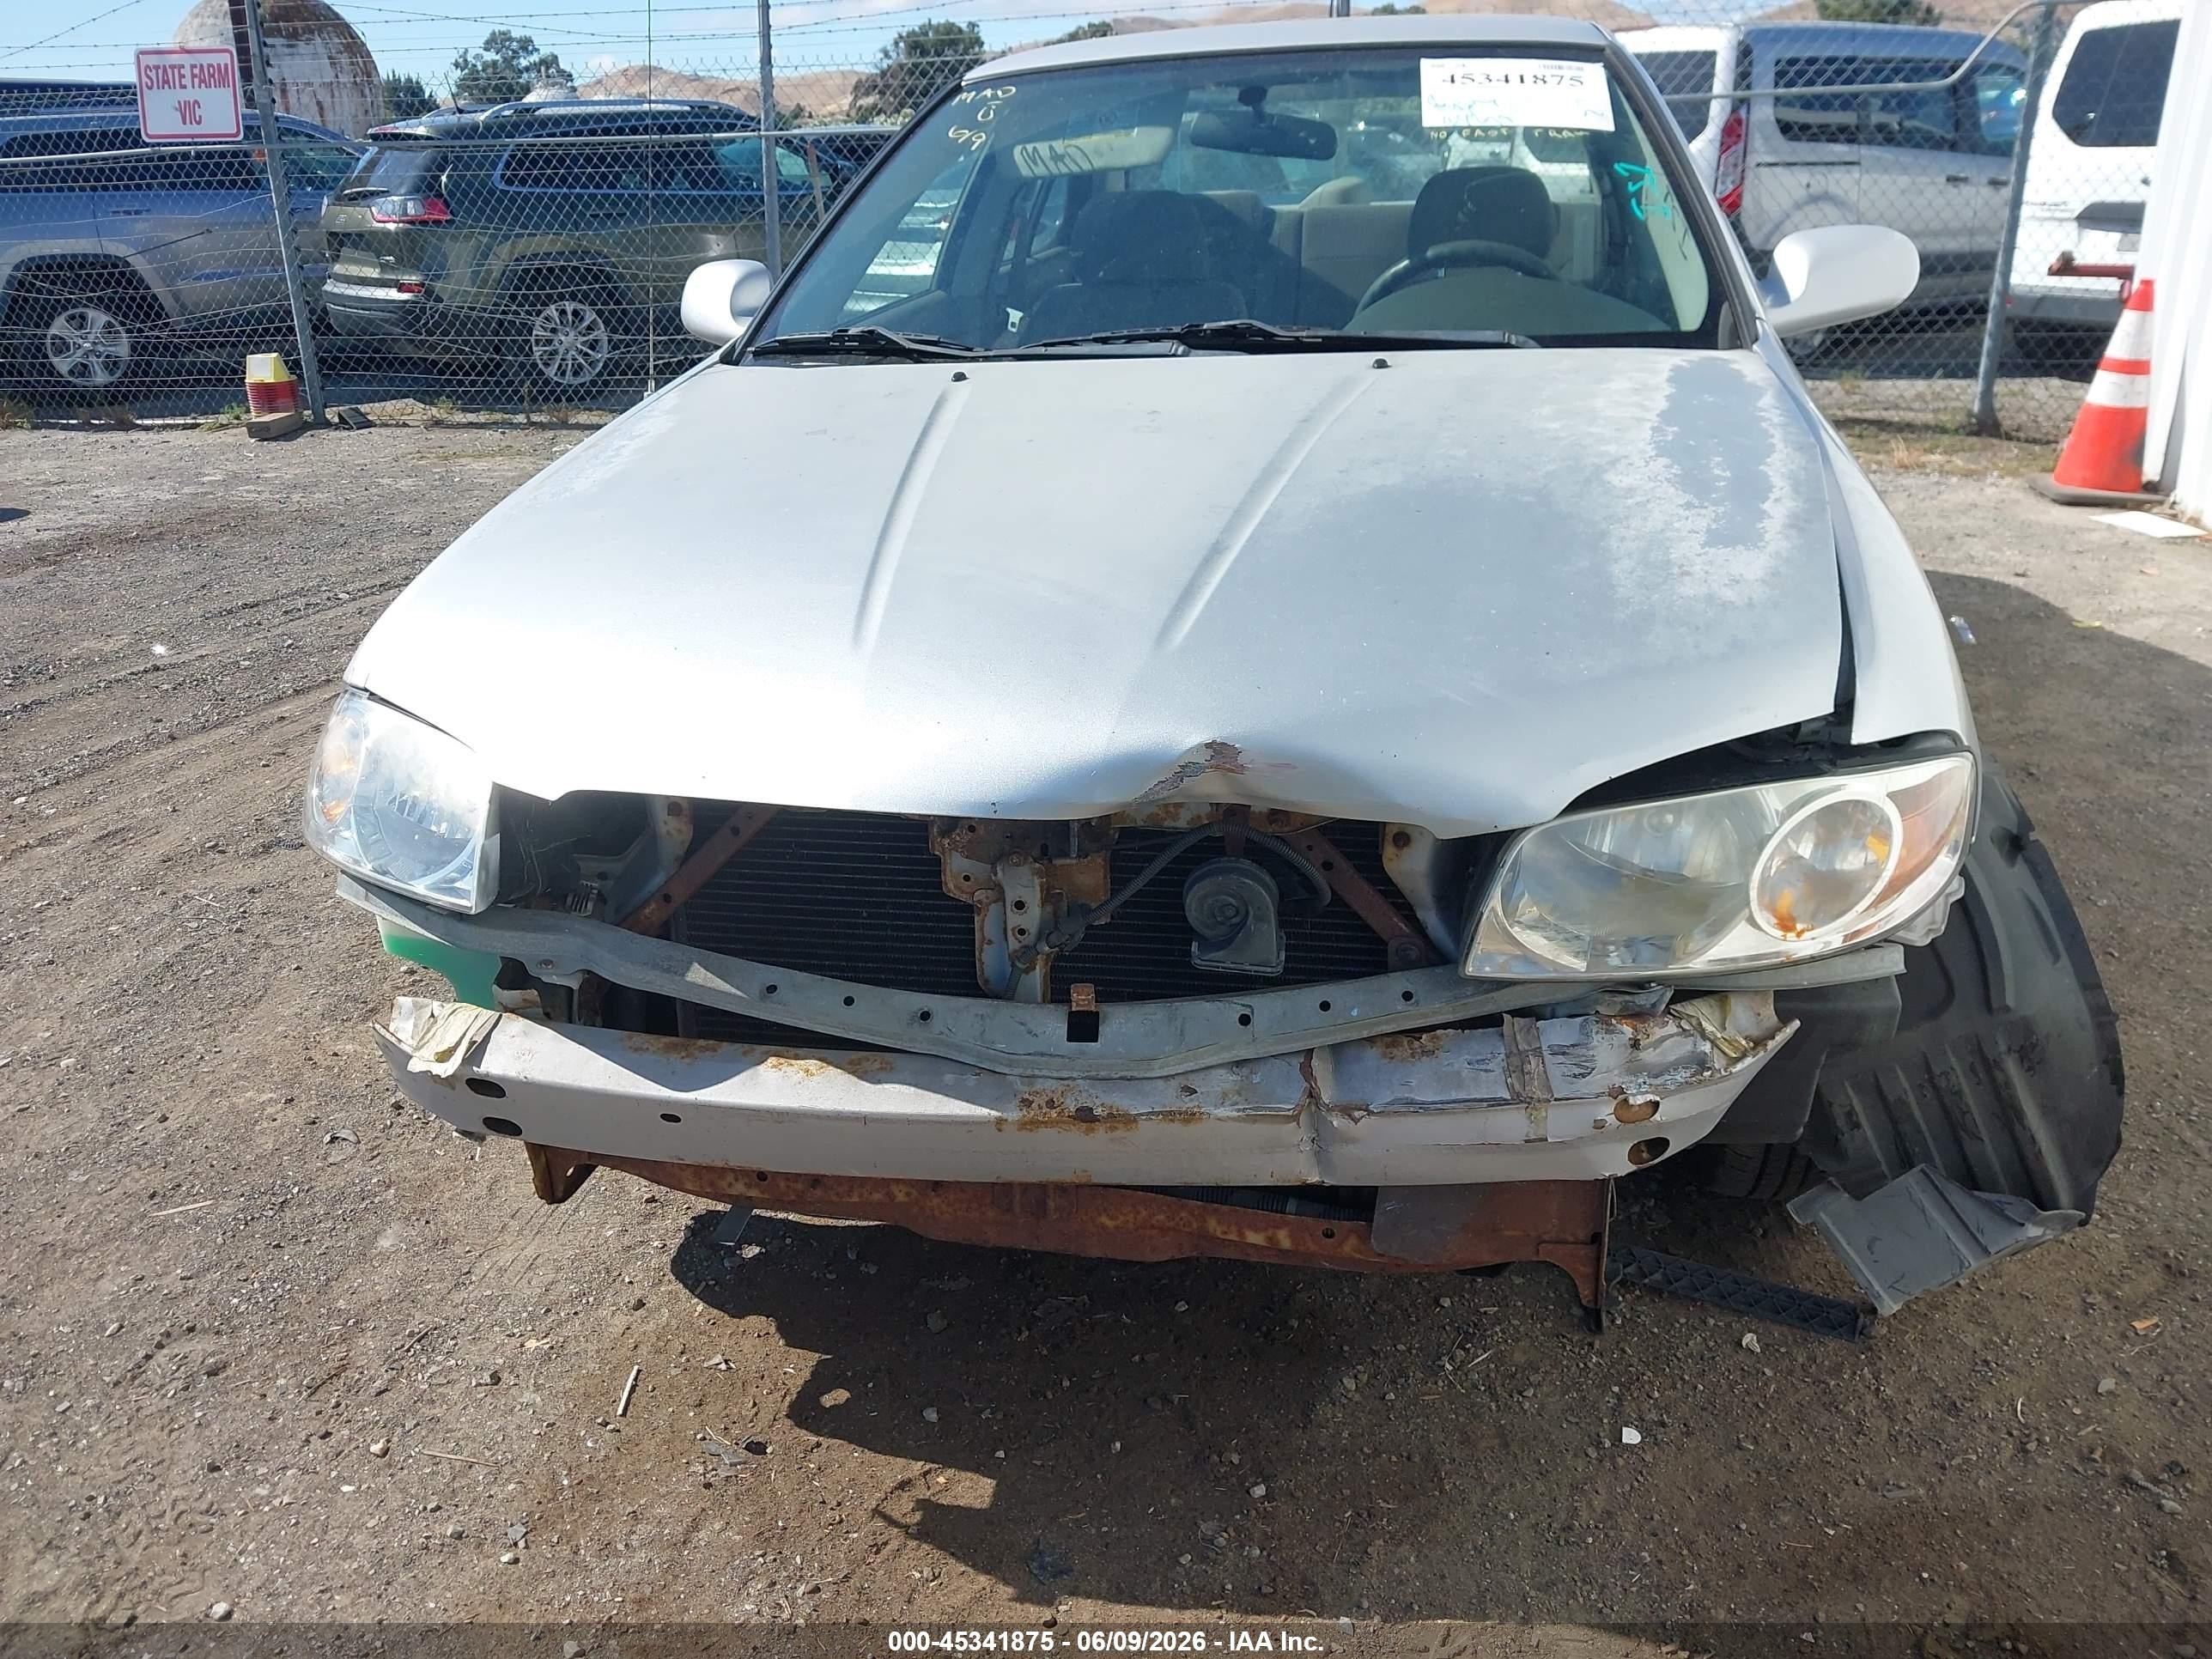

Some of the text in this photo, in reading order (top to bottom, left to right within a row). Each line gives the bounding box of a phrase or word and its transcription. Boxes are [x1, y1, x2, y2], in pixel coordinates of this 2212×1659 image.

[144, 63, 230, 90] STATE FARM
[1442, 72, 1584, 88] 45341875
[951, 86, 1017, 106] MAD
[177, 99, 203, 125] VIC
[947, 125, 987, 151] 6/9
[1429, 130, 1448, 140] NO
